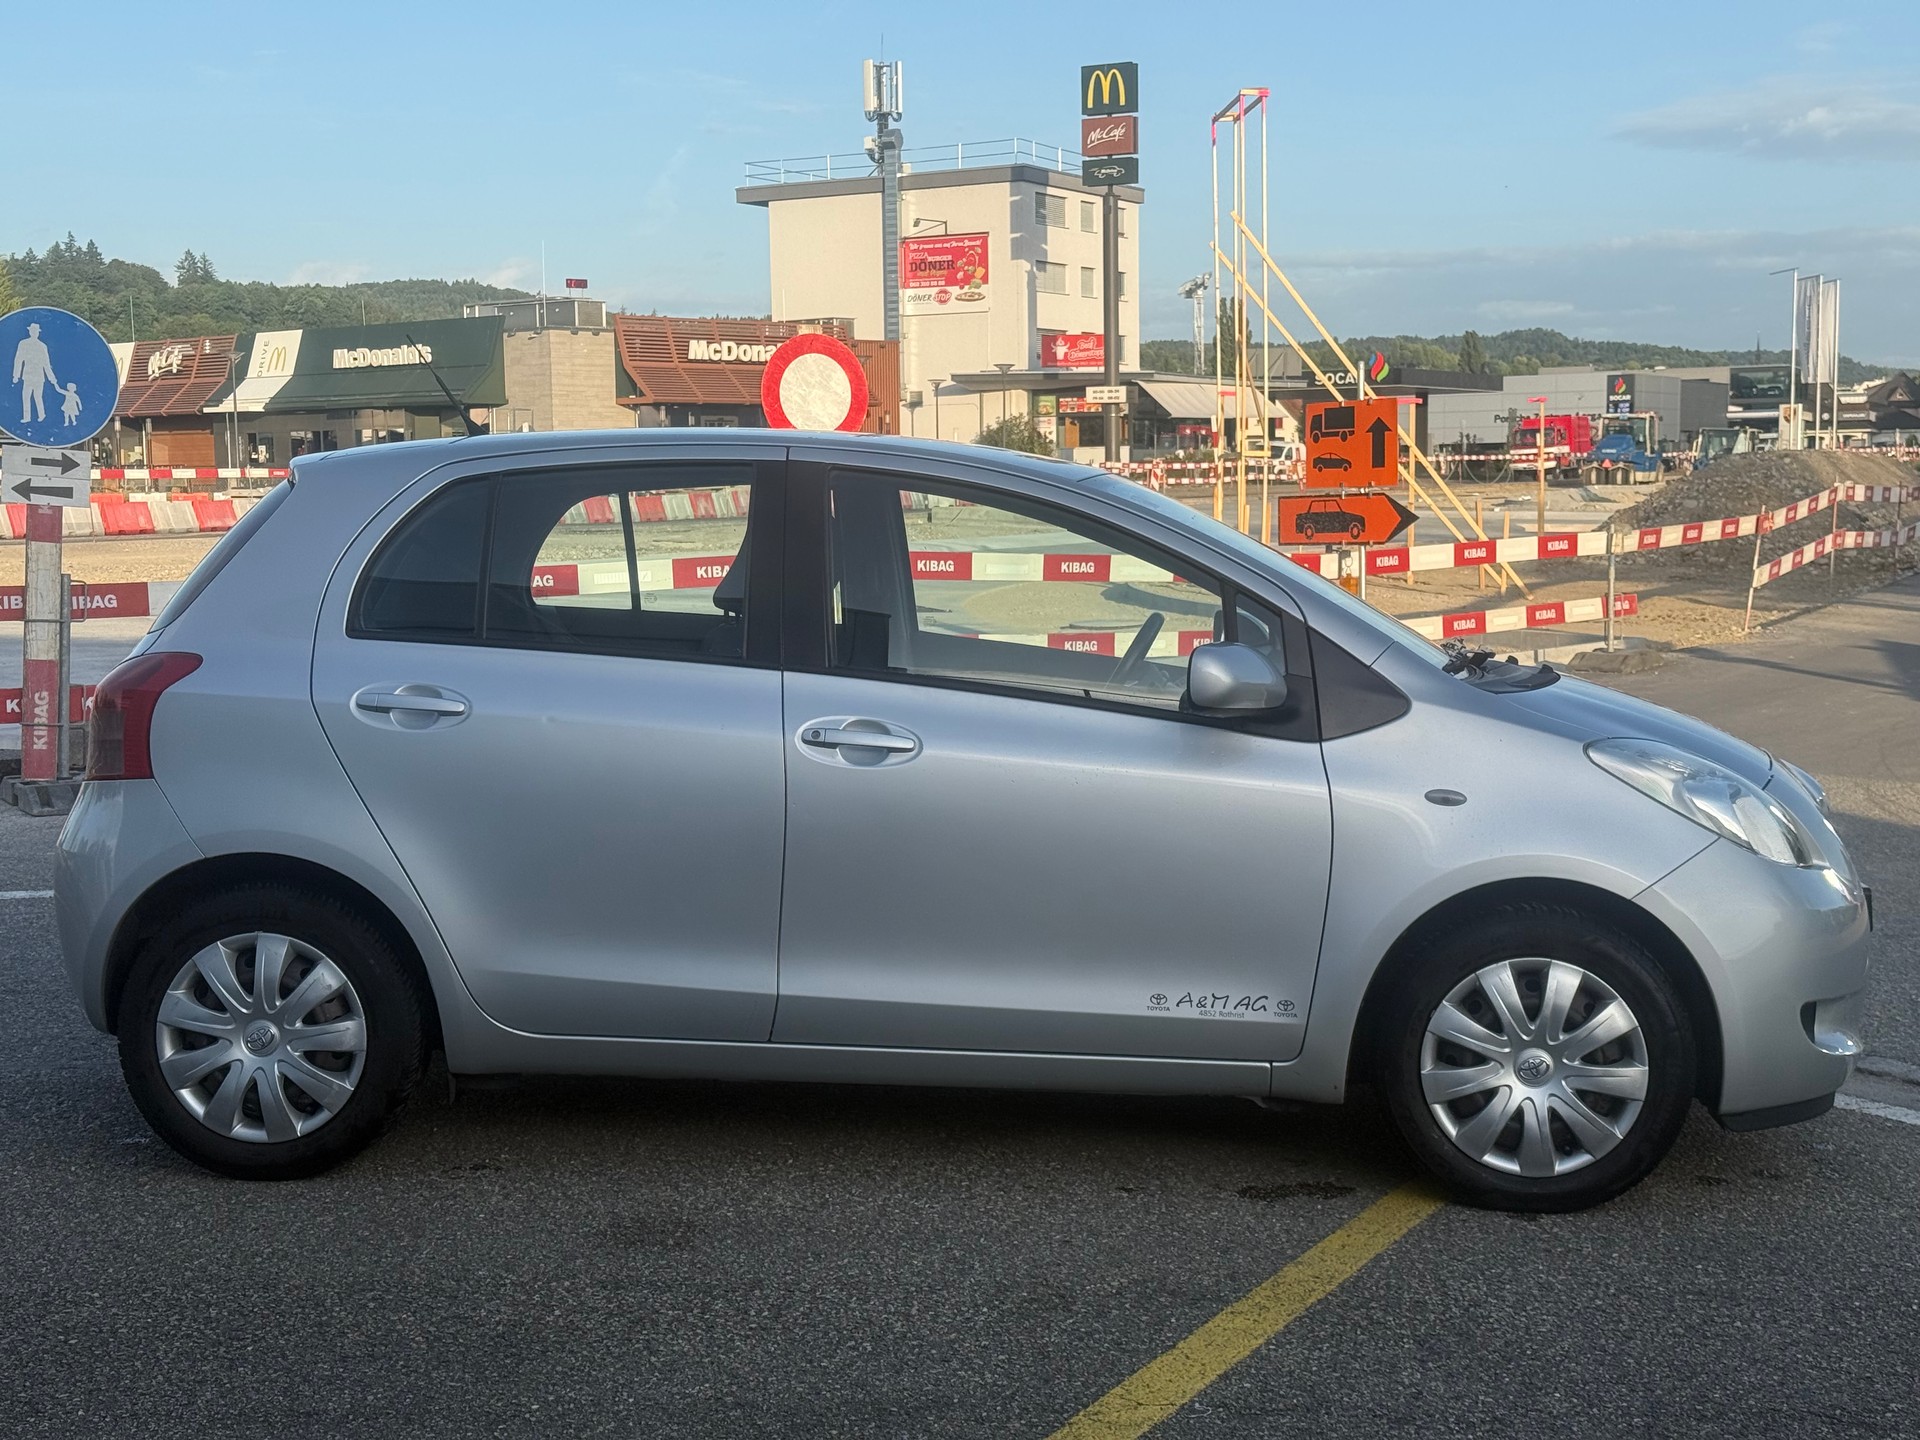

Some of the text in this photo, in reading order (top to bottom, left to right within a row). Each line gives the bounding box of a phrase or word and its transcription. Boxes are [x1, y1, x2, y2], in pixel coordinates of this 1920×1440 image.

[909, 252, 929, 260] PIZZA
[909, 260, 955, 272] DÖNER
[907, 292, 952, 303] DÖNER STOP
[332, 343, 433, 369] McDonald's
[687, 339, 784, 362] McDona
[257, 340, 270, 378] DRIVE
[1314, 372, 1358, 385] SOCA
[1547, 539, 1569, 551] KIBAG
[1464, 547, 1487, 559] KIBAG
[917, 559, 955, 573] KIBAG
[1061, 561, 1095, 574] KIBAG
[1376, 556, 1399, 567] KIBAG
[696, 565, 731, 579] KIBA
[71, 594, 118, 610] IBAG
[1535, 608, 1556, 620] KIBAG
[1453, 618, 1476, 631] KIBAG
[1064, 640, 1098, 652] KIBAG
[33, 691, 49, 750] KIBAG
[1233, 995, 1269, 1012] AG
[1198, 1009, 1245, 1019] 4852 Rothrist
